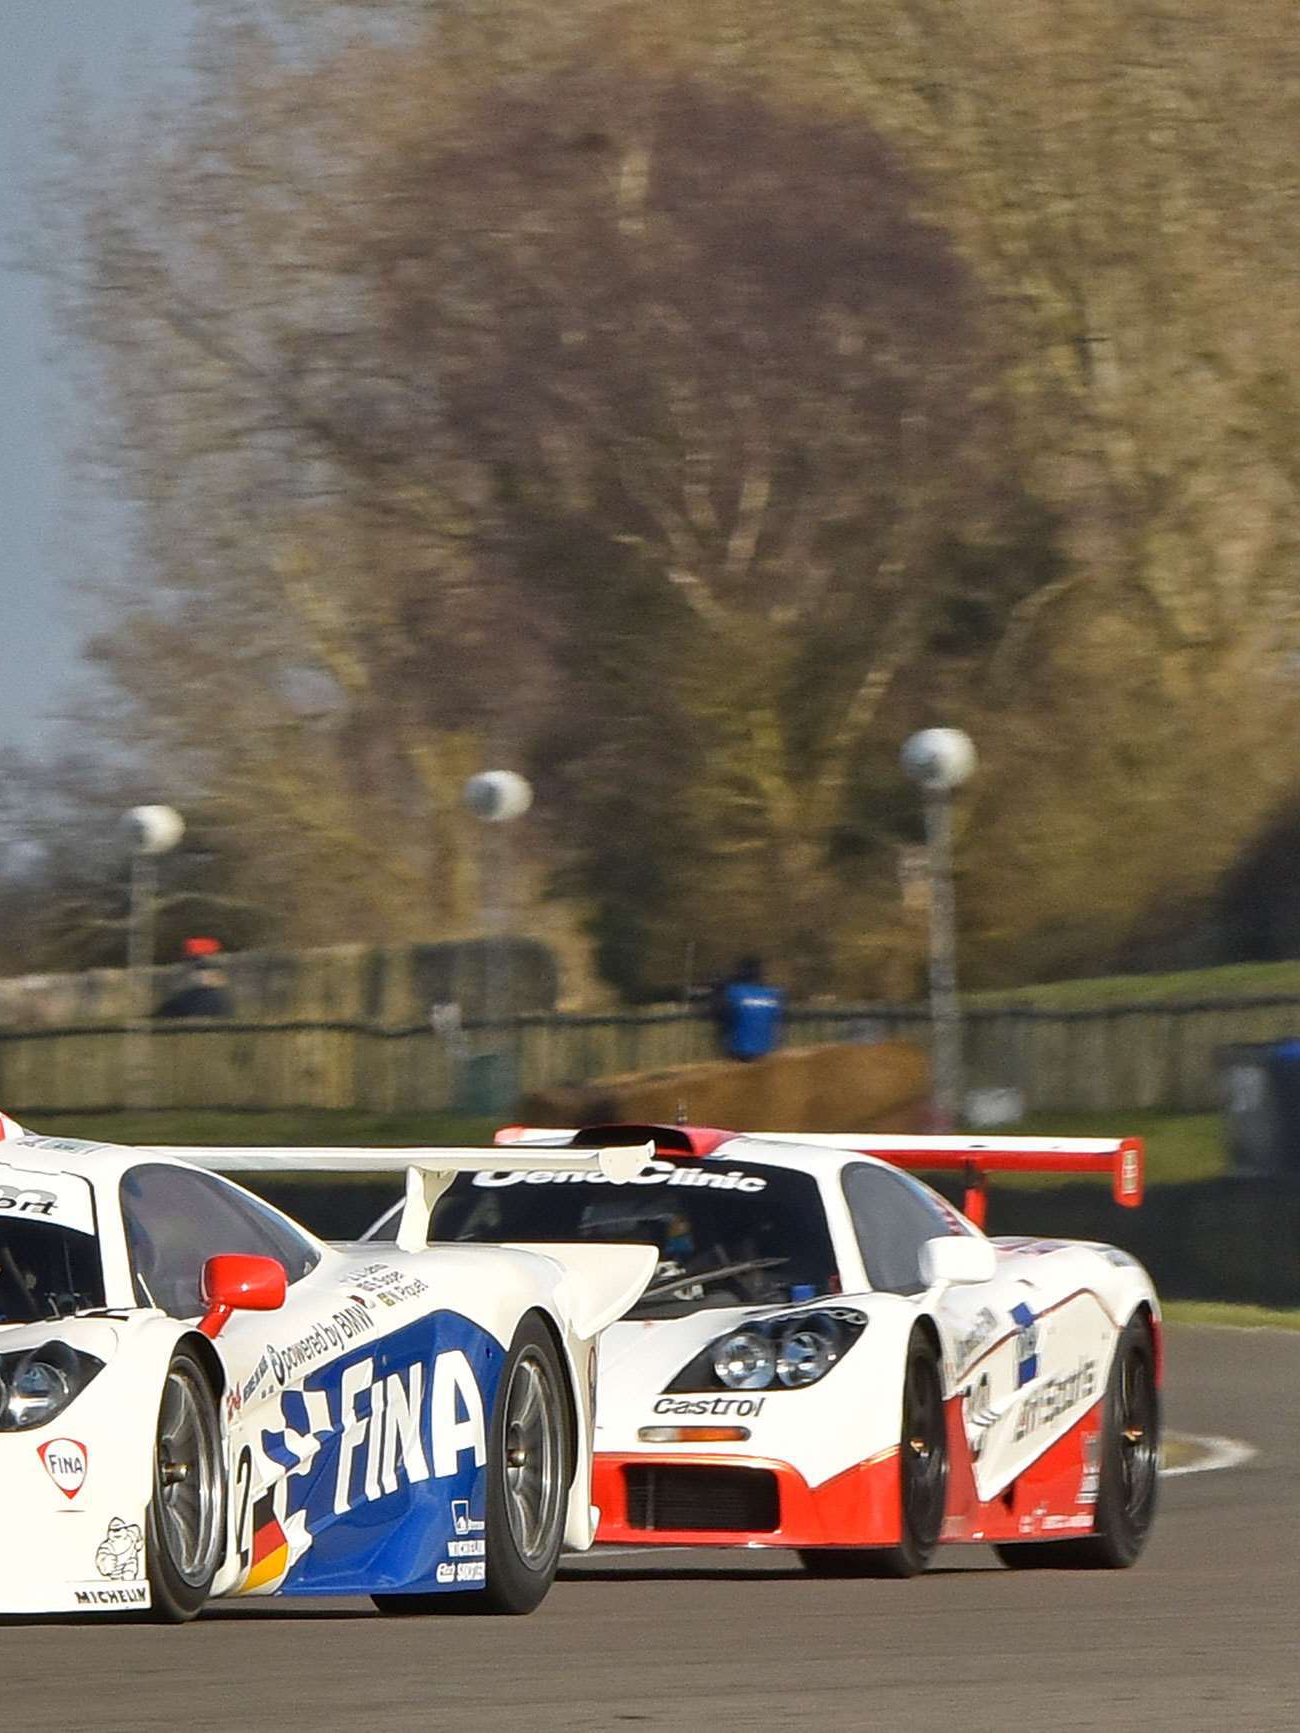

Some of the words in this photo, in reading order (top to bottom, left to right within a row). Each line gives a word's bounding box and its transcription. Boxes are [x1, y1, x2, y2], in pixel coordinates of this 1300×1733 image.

[332, 1303, 374, 1339] BMW
[282, 1322, 329, 1379] powered
[322, 1322, 345, 1351] by
[653, 1398, 766, 1417] Castrol
[334, 1350, 487, 1515] FINA
[48, 1454, 83, 1474] FINA
[74, 1587, 146, 1604] MICHELIN
